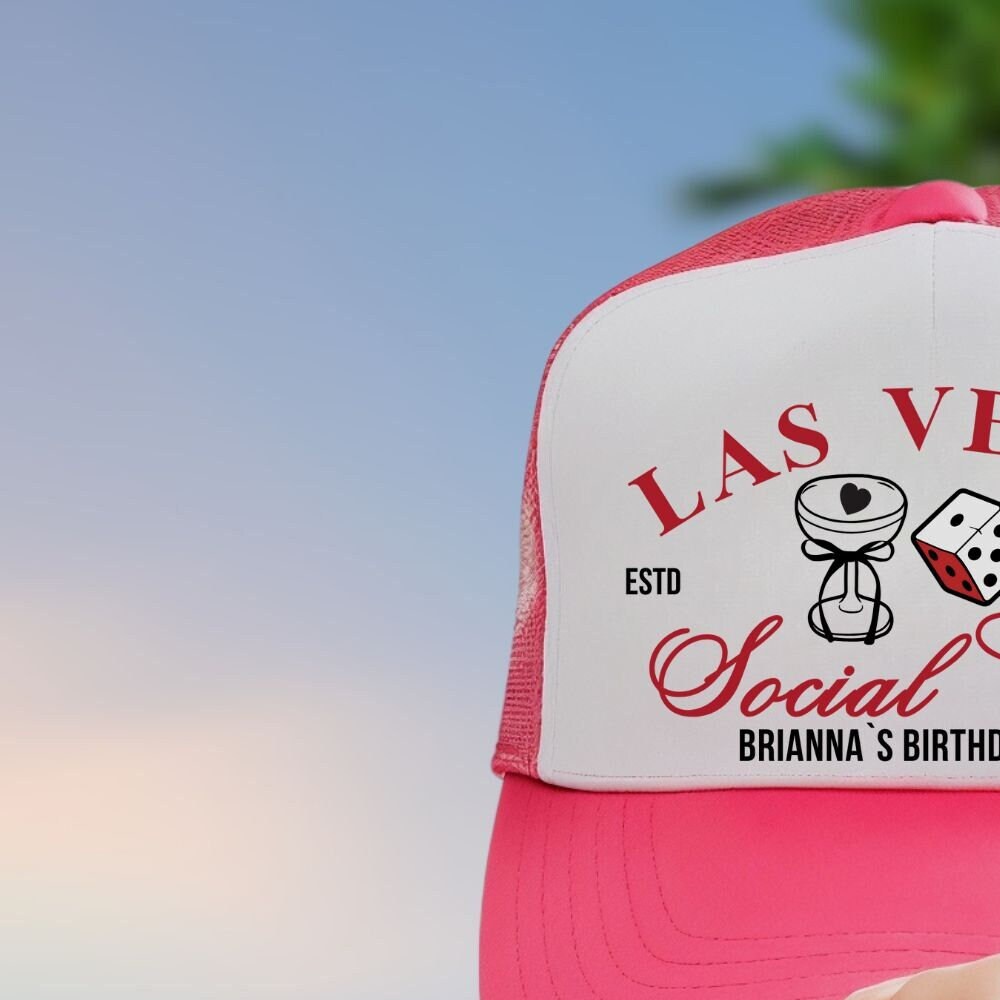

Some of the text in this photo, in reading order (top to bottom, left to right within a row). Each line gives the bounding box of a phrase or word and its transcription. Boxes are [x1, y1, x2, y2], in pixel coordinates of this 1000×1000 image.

[627, 401, 831, 537] LAS
[624, 566, 682, 597] ESTD
[647, 613, 973, 720] Social
